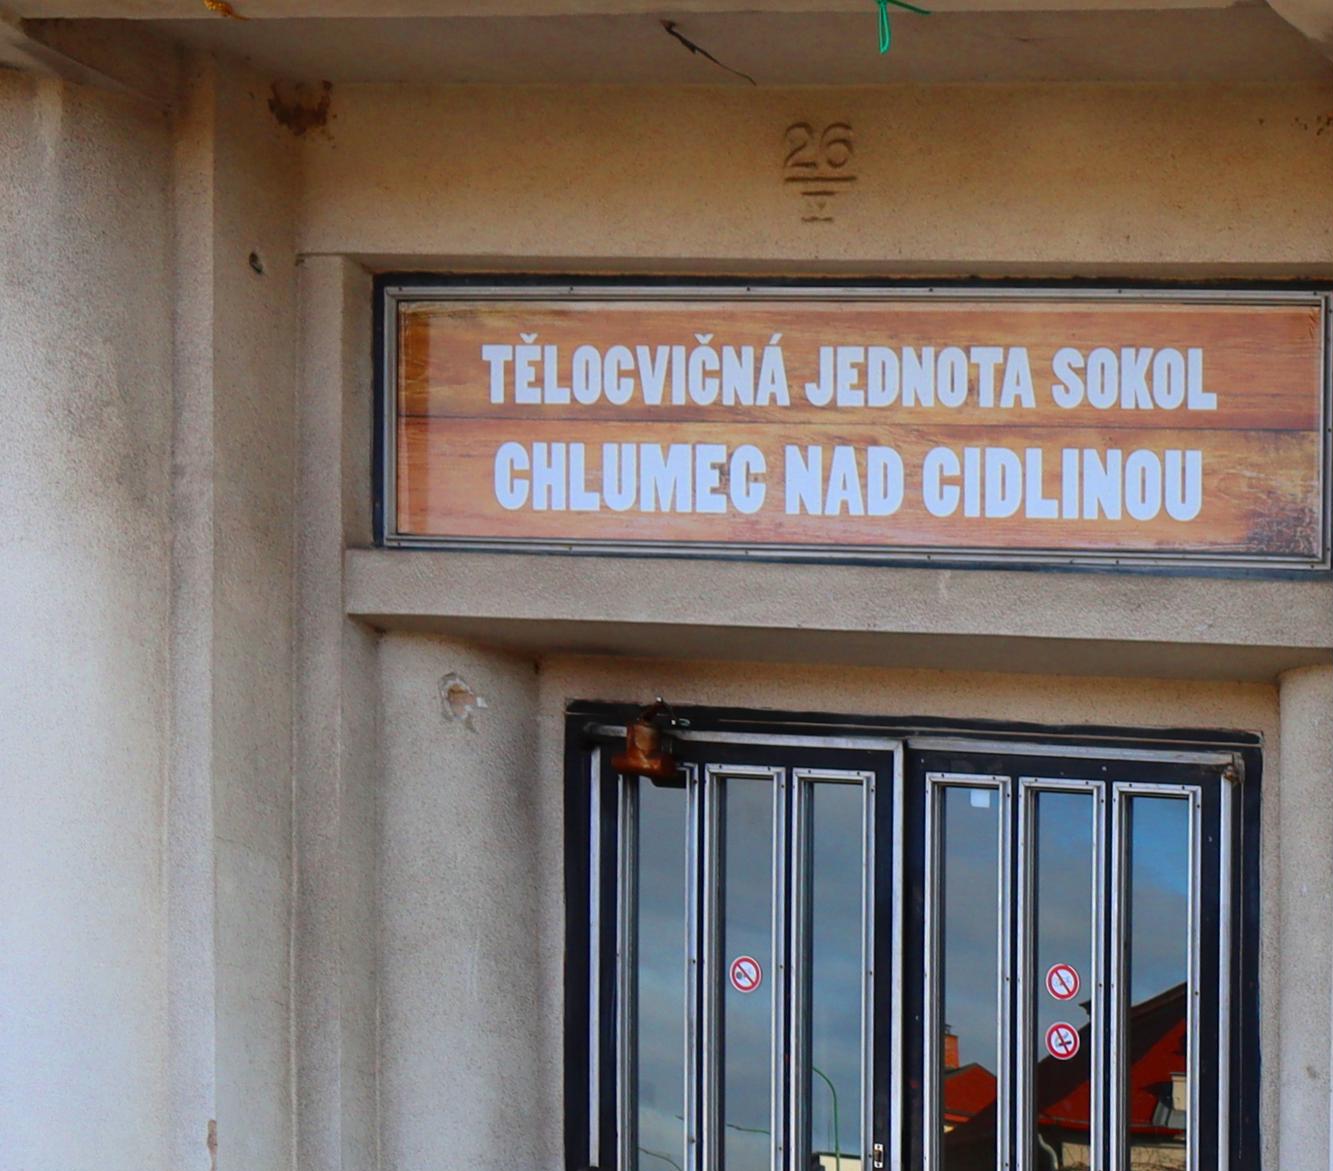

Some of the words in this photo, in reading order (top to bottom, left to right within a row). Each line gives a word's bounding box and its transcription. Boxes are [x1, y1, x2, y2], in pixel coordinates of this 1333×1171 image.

[784, 121, 854, 168] 26
[481, 334, 790, 406] TĚLOCVIČNÁ
[805, 346, 1035, 409] JEDNOTA
[1052, 347, 1217, 410] SOKOL
[494, 441, 768, 515] CHLUMEC
[783, 444, 905, 517] NAD
[922, 445, 1203, 522] CIDLINOU
